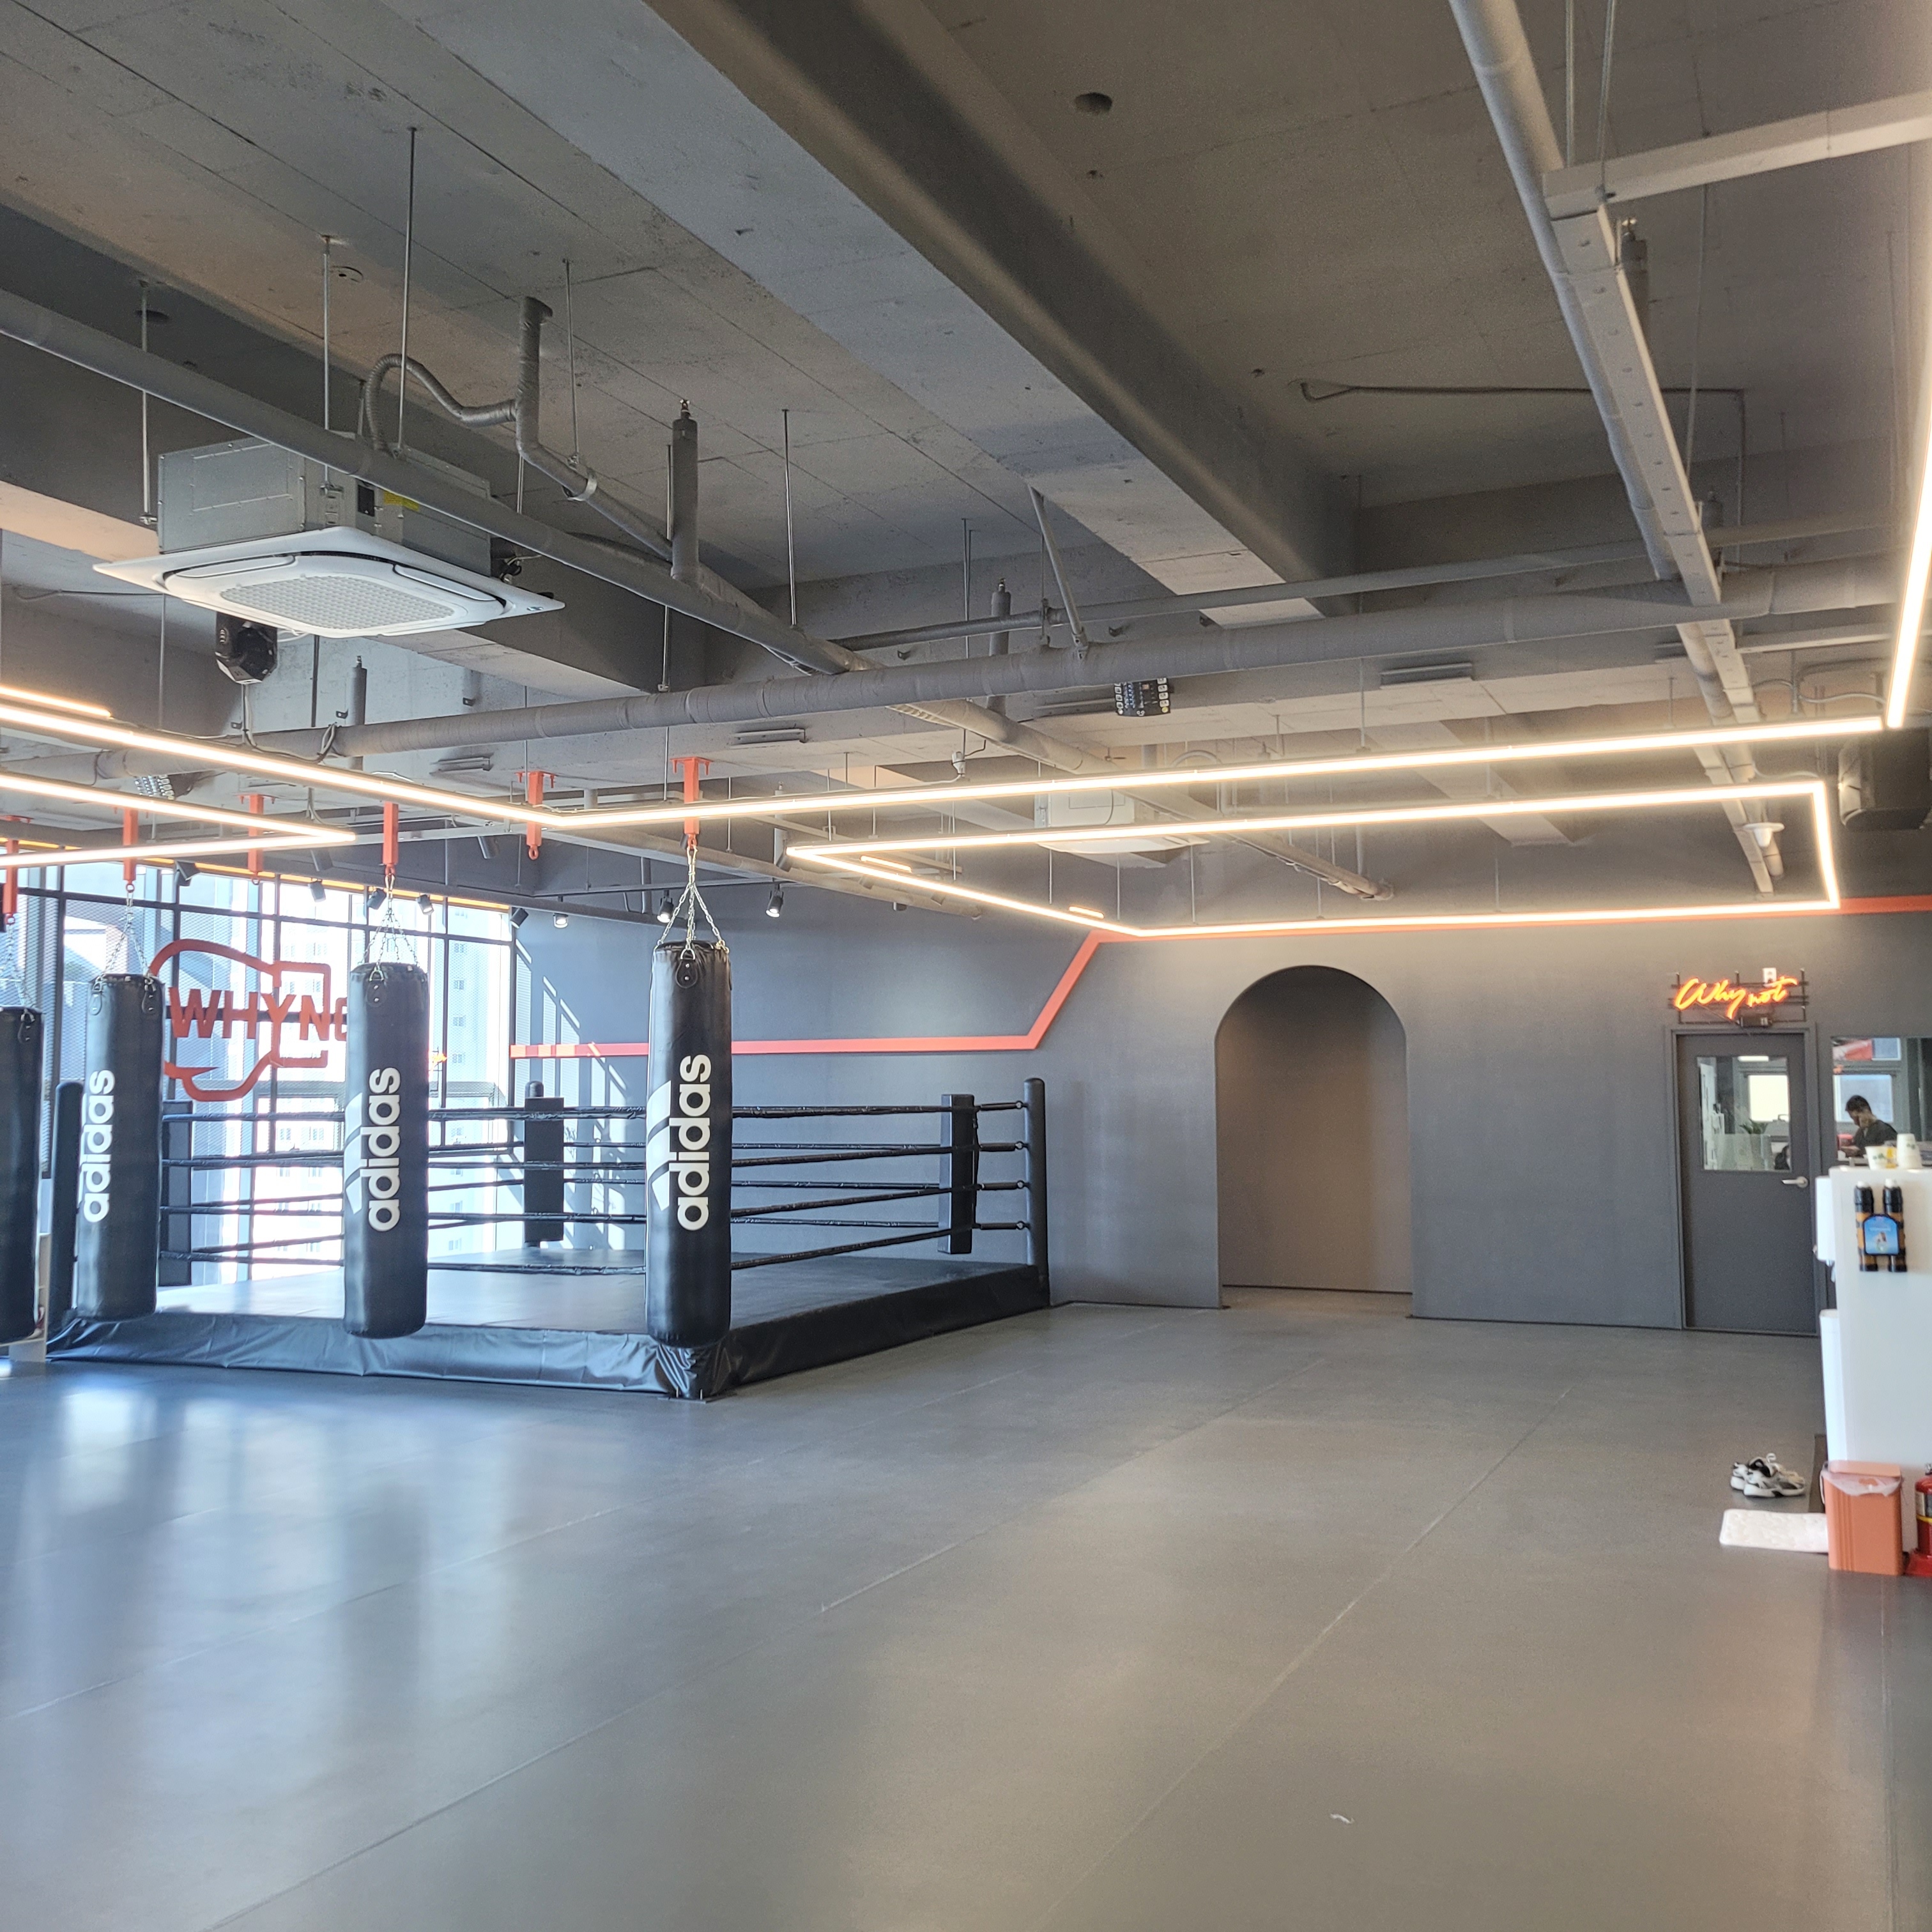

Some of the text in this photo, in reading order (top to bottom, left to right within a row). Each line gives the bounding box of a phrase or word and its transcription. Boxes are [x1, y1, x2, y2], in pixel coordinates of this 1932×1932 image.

[1675, 976, 1798, 1019] Why not
[81, 1070, 116, 1223] adidas
[360, 1067, 401, 1232] adidas
[669, 1054, 711, 1230] adidas
